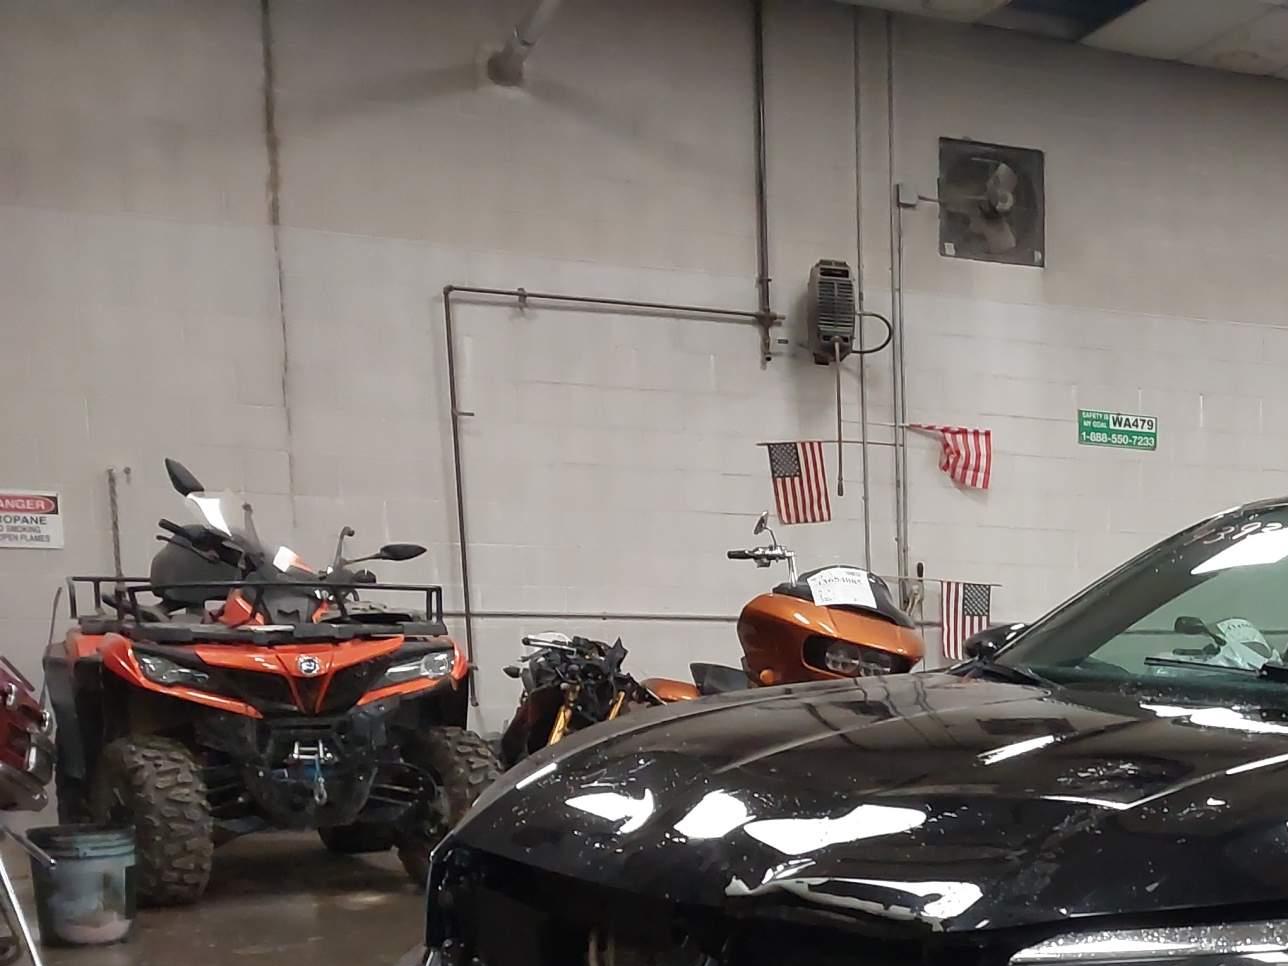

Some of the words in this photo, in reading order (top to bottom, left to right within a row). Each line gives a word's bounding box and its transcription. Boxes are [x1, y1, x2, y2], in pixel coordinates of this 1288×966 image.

[1081, 411, 1102, 420] SAFETY
[1111, 415, 1154, 430] WA479
[1081, 431, 1155, 447] 1-888-550-7233
